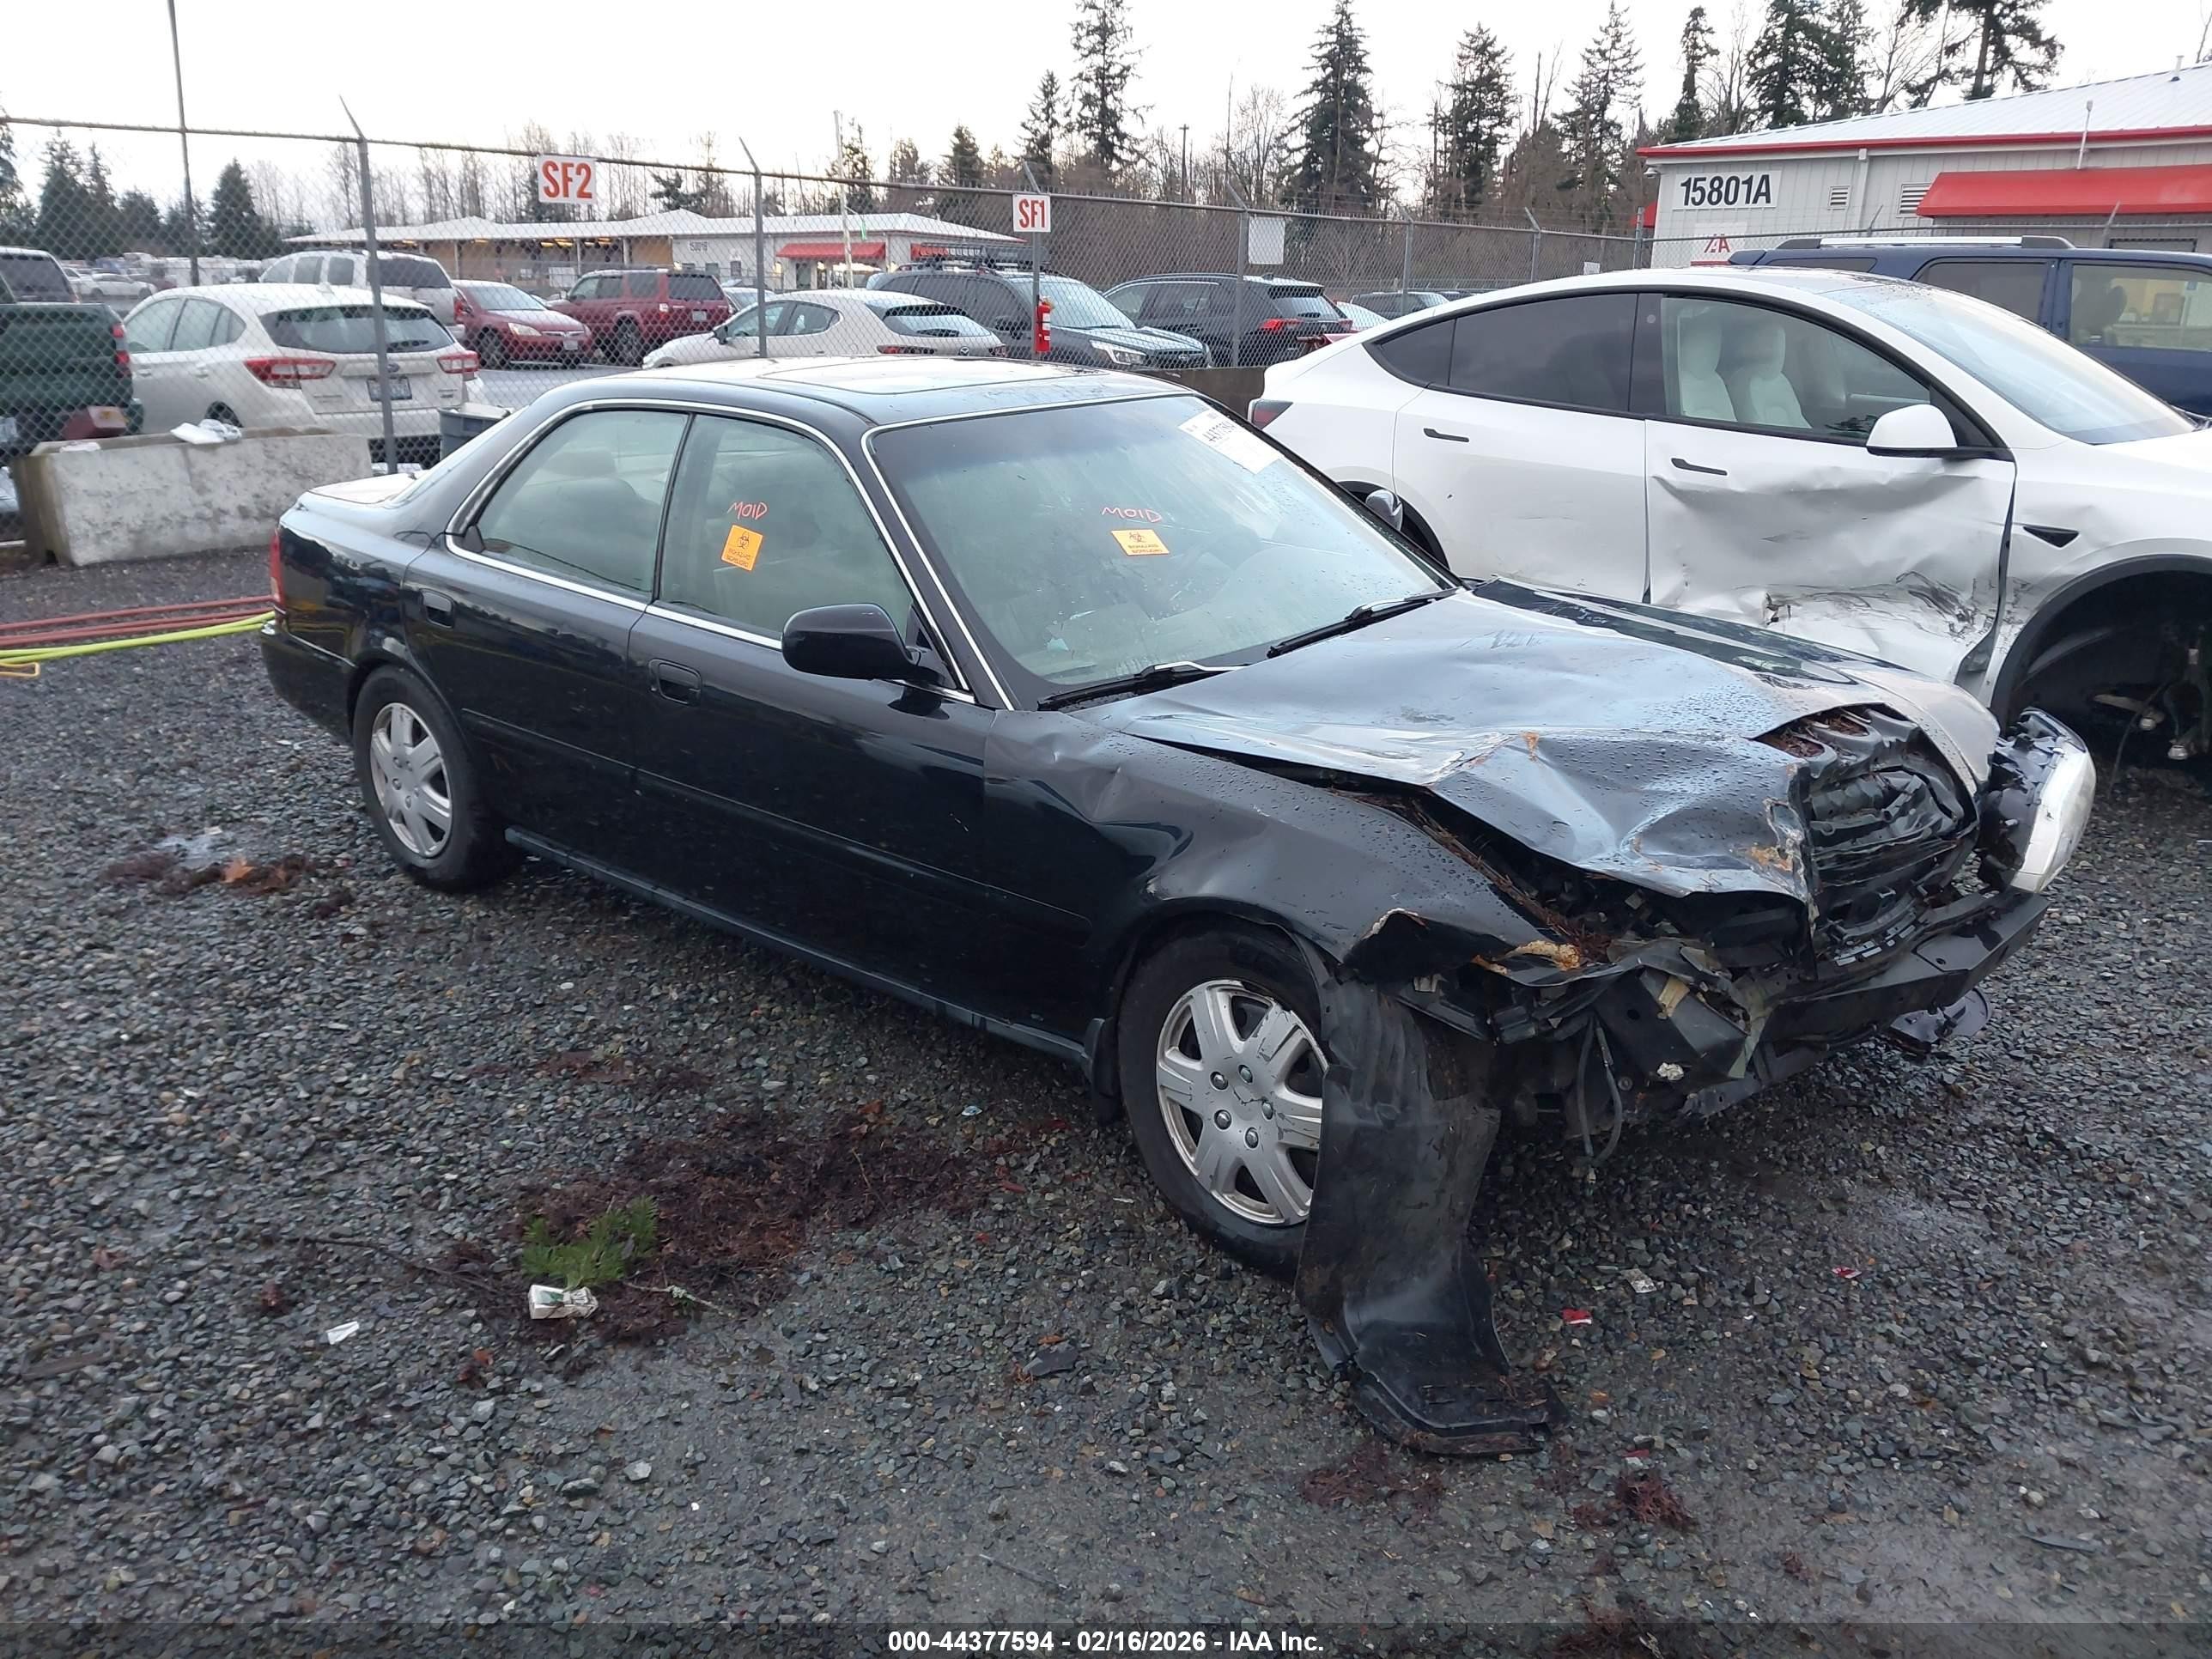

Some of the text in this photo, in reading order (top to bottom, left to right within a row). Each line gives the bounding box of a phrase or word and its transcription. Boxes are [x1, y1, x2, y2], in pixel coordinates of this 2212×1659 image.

[542, 161, 592, 198] SF2
[1680, 174, 1771, 205] 15801A
[1018, 198, 1045, 228] SF1
